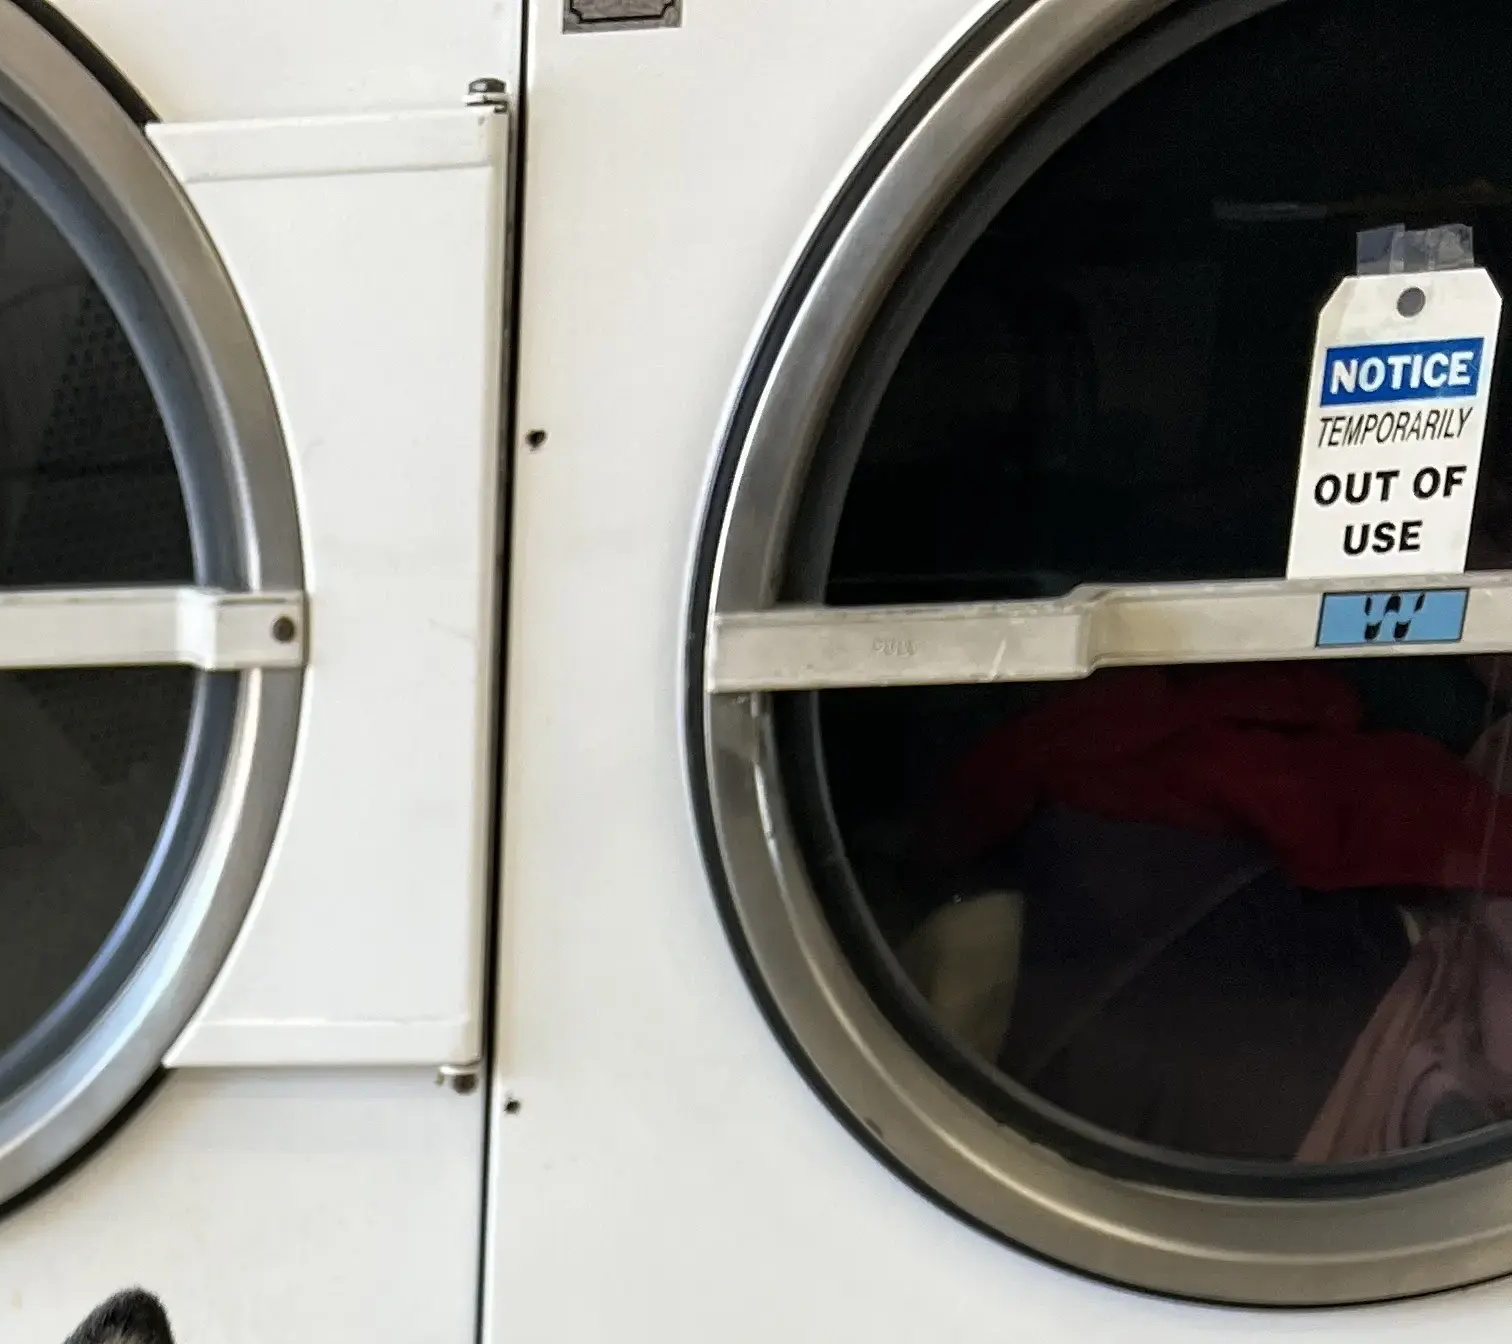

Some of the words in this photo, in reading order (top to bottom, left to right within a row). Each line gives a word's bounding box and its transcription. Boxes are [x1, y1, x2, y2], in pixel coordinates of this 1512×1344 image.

[1328, 350, 1475, 396] NOTICE
[1317, 407, 1473, 448] TEMPORARILY
[1313, 470, 1400, 506] OUT
[1413, 465, 1467, 500] OF
[1343, 520, 1423, 556] USE
